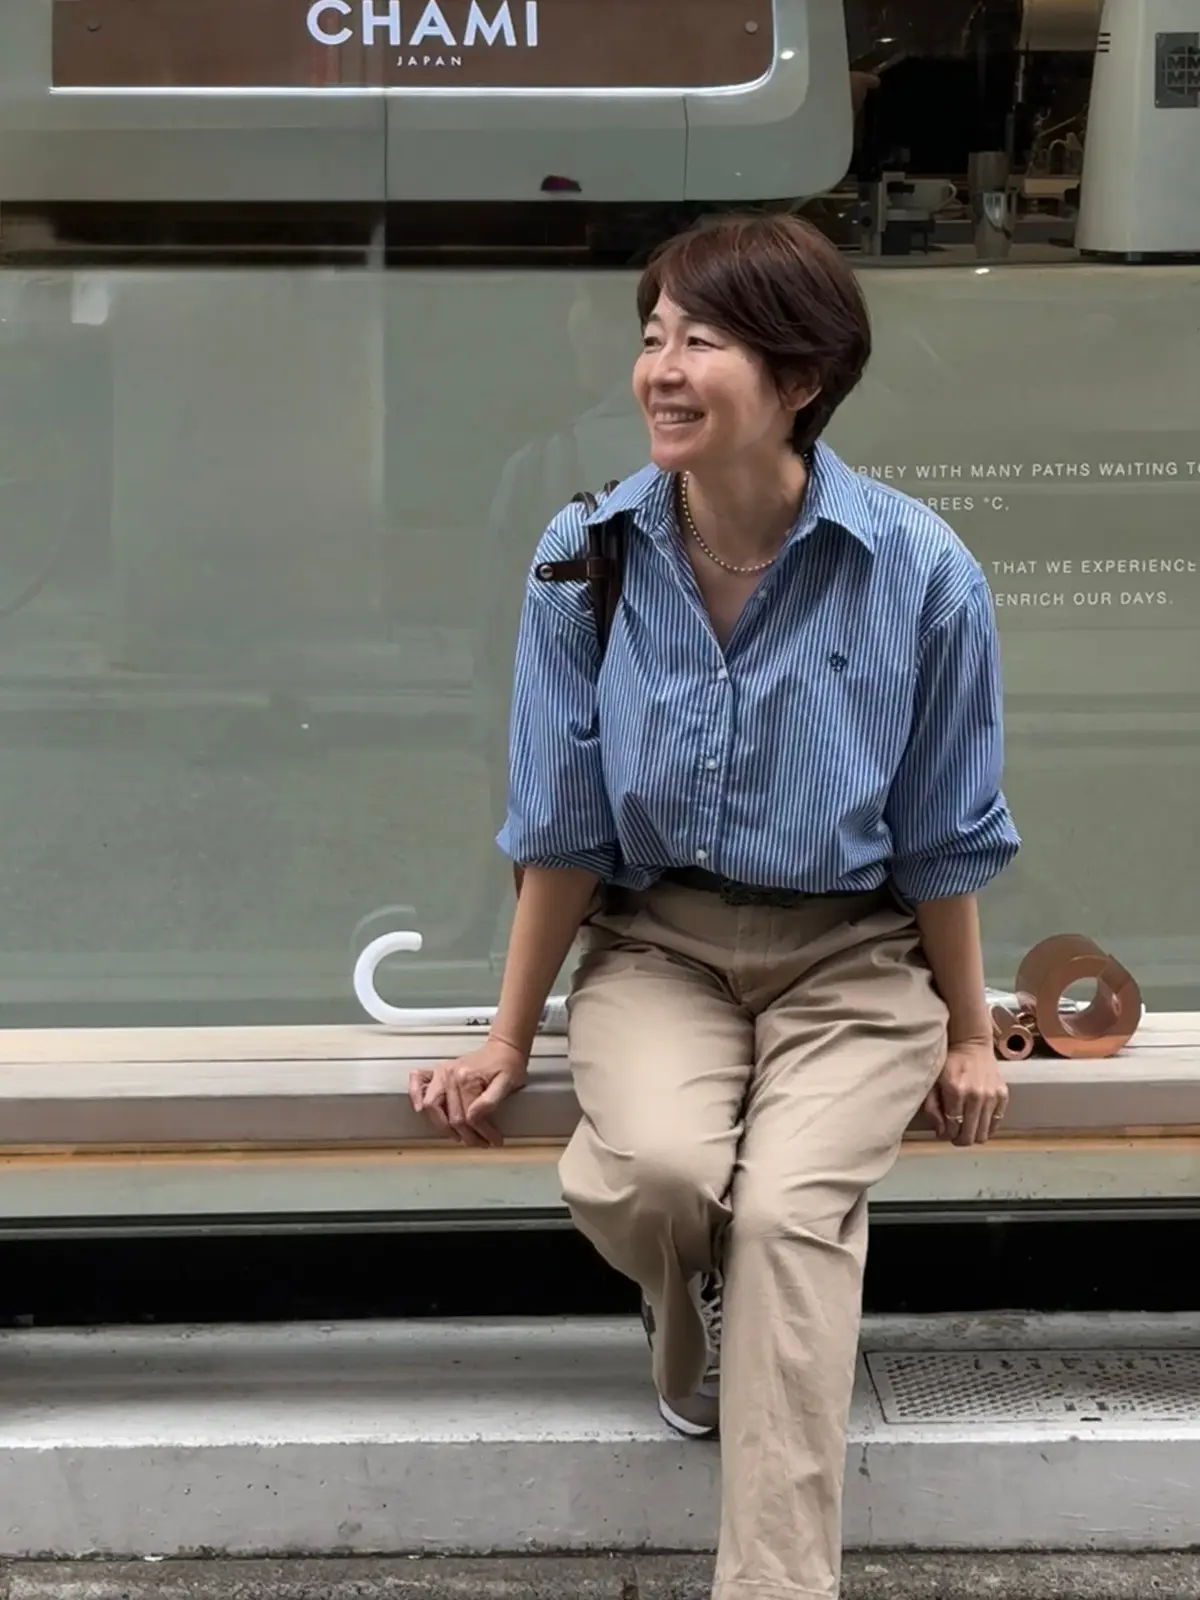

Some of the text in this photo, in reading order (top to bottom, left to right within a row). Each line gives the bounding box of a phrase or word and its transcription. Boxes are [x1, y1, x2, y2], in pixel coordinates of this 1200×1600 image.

[306, 0, 538, 47] CHAMI
[397, 56, 462, 67] JAPAN
[851, 465, 907, 479] RNEY
[915, 464, 963, 478] WITH
[971, 463, 1023, 478] MANY
[1032, 463, 1090, 477] PATHS
[1099, 461, 1178, 476] WAITING
[917, 496, 974, 511] REES
[992, 558, 1197, 574] THAT WE EXPERIENCE
[995, 591, 1174, 607] ENRICH OUR DAYS.
